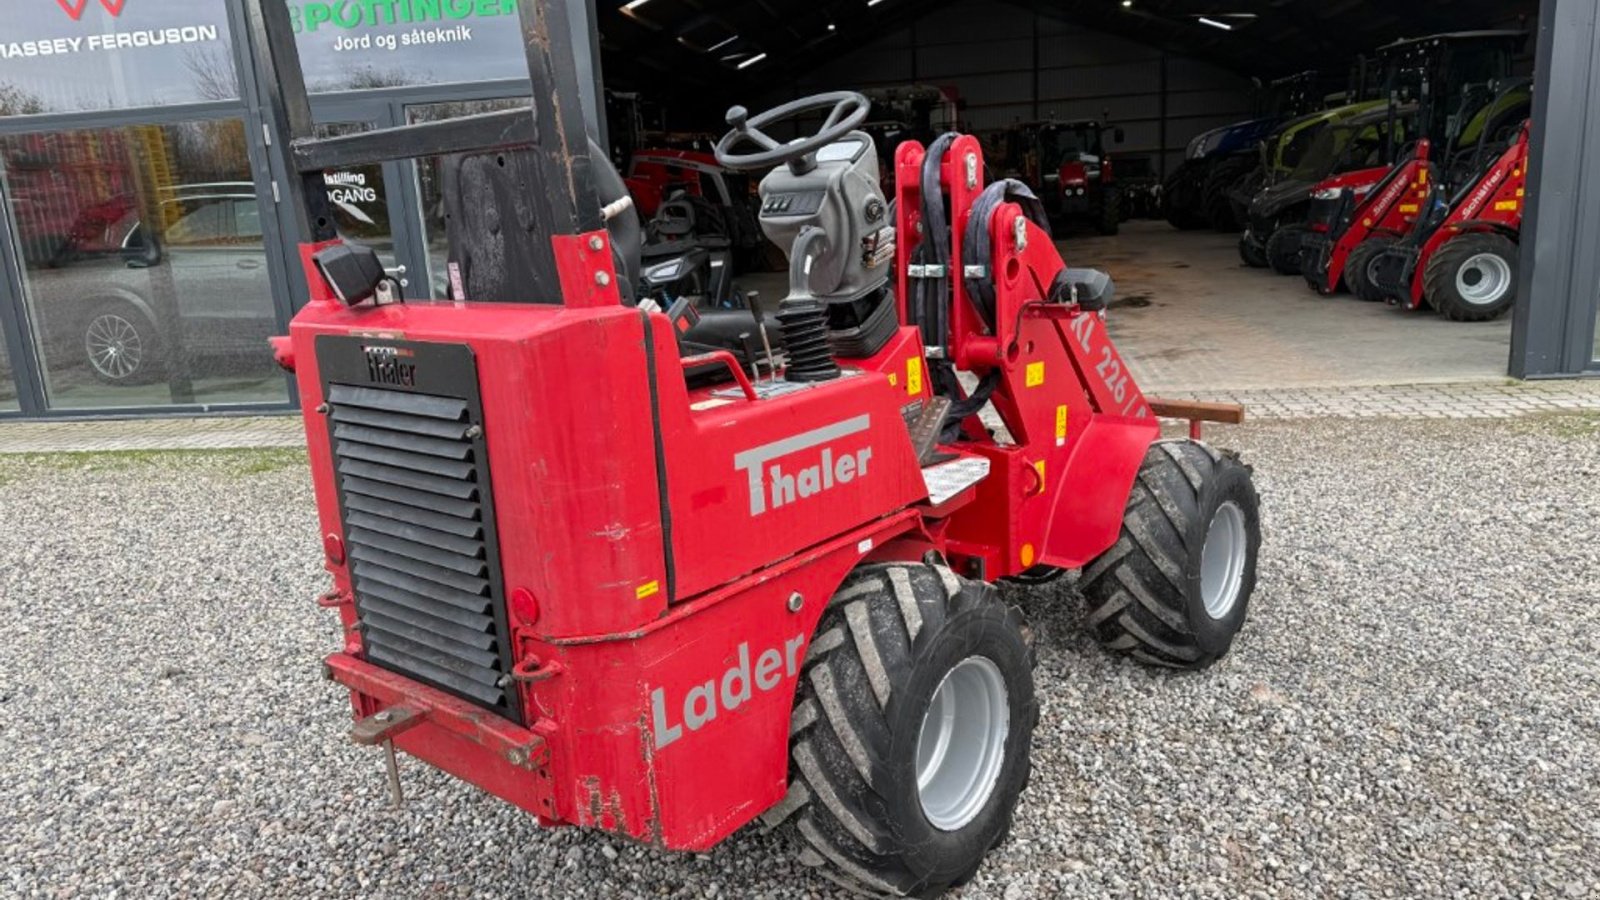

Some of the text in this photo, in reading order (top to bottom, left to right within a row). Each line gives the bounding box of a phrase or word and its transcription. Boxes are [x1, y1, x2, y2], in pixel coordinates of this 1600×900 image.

[88, 25, 218, 50] FERGUSON
[334, 25, 472, 51] Jord og såteknik
[1461, 169, 1502, 220] Schäffer
[734, 412, 872, 517] Thaler
[651, 632, 805, 750] Lader
